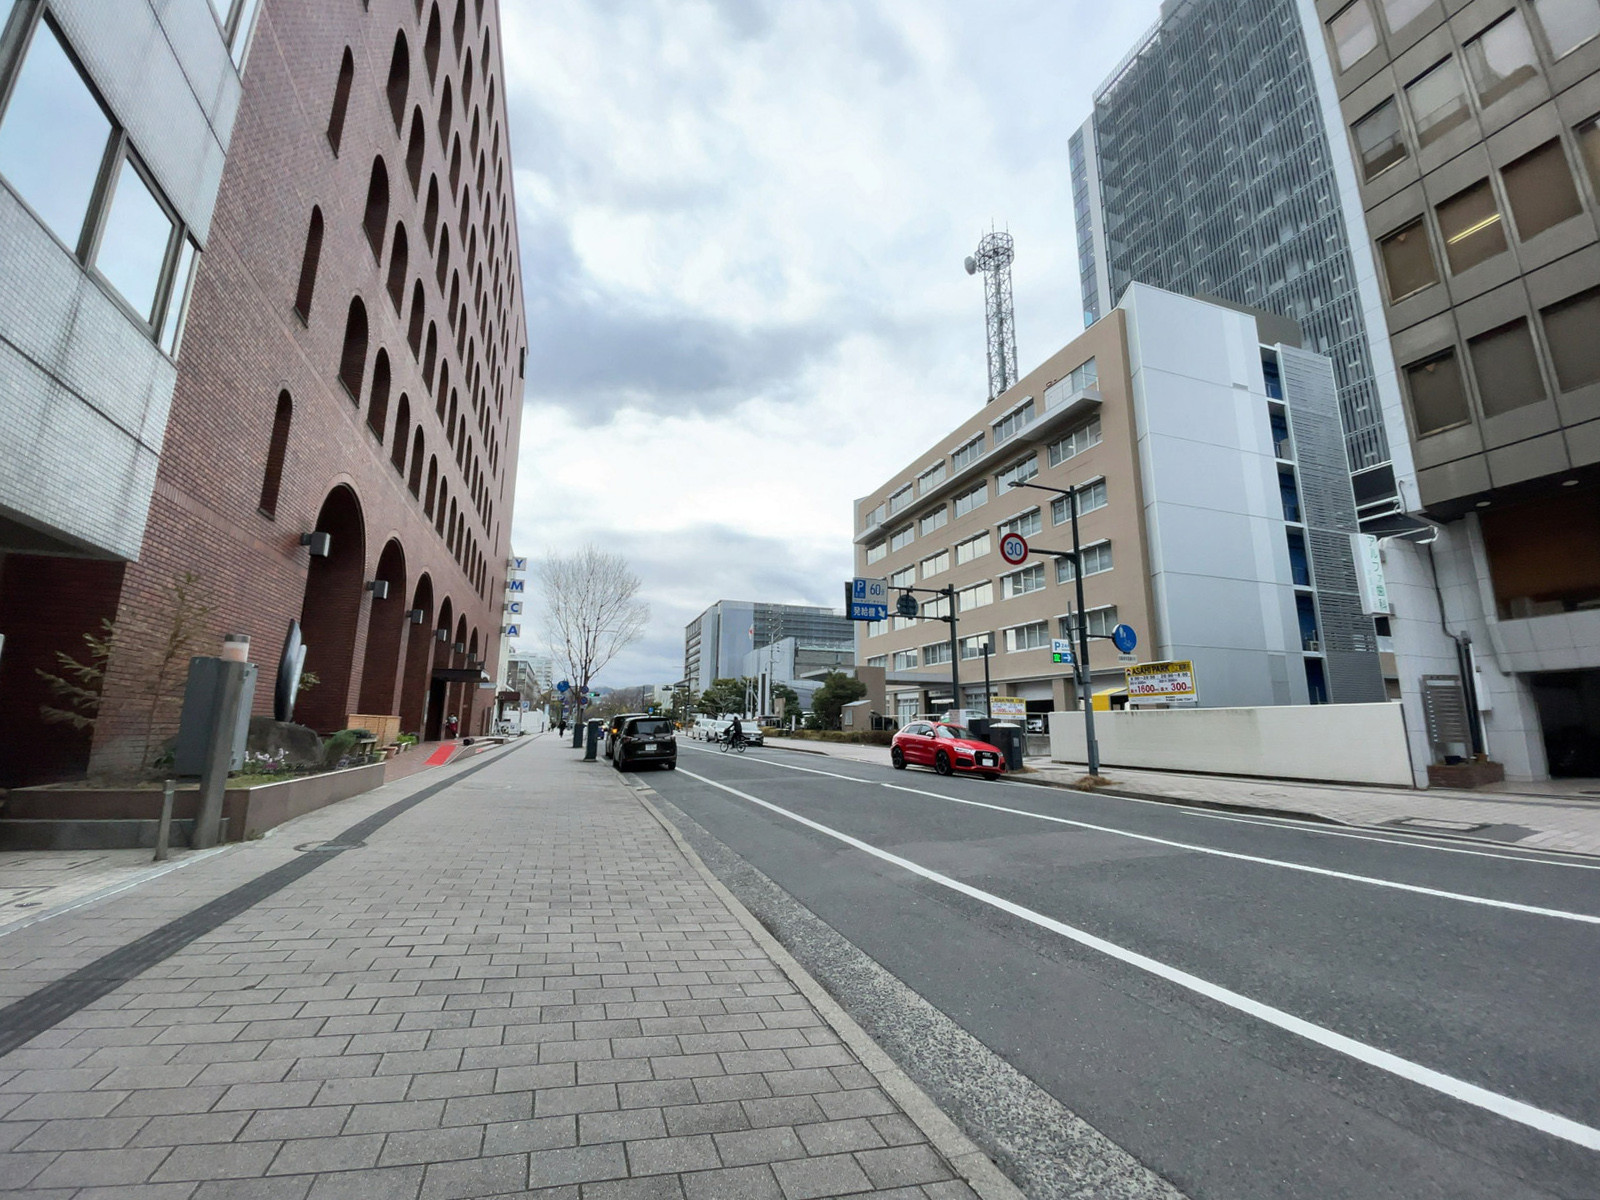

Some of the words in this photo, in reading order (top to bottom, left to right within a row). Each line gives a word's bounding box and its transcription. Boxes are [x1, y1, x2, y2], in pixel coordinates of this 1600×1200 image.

[1006, 541, 1023, 557] 30
[857, 581, 864, 592] P
[1054, 641, 1061, 651] P
[1152, 664, 1170, 674] PARK
